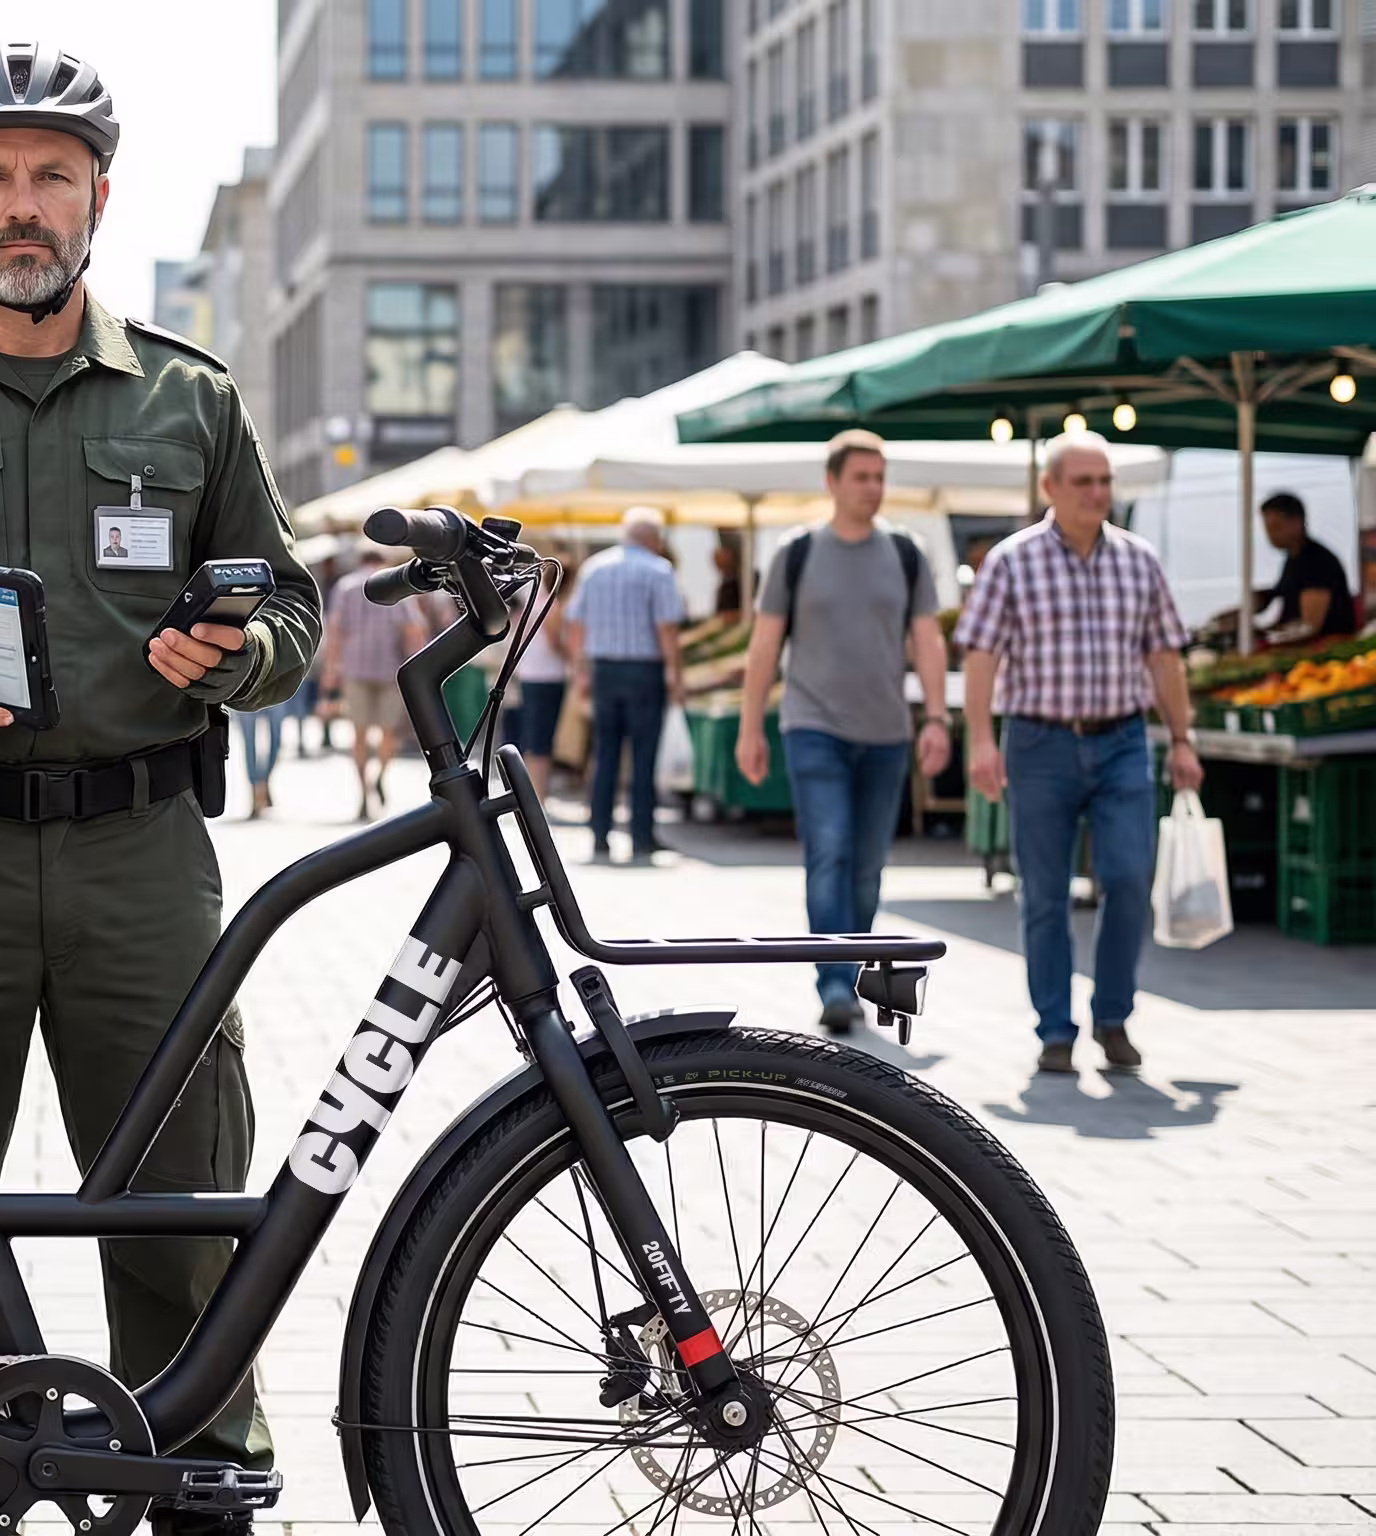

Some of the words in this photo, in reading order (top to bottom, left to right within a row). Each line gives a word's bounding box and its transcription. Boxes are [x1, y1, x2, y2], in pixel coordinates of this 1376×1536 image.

[288, 934, 463, 1195] CYCLE
[707, 1069, 787, 1081] PICK-UP
[642, 1240, 693, 1315] 20FIFTY
